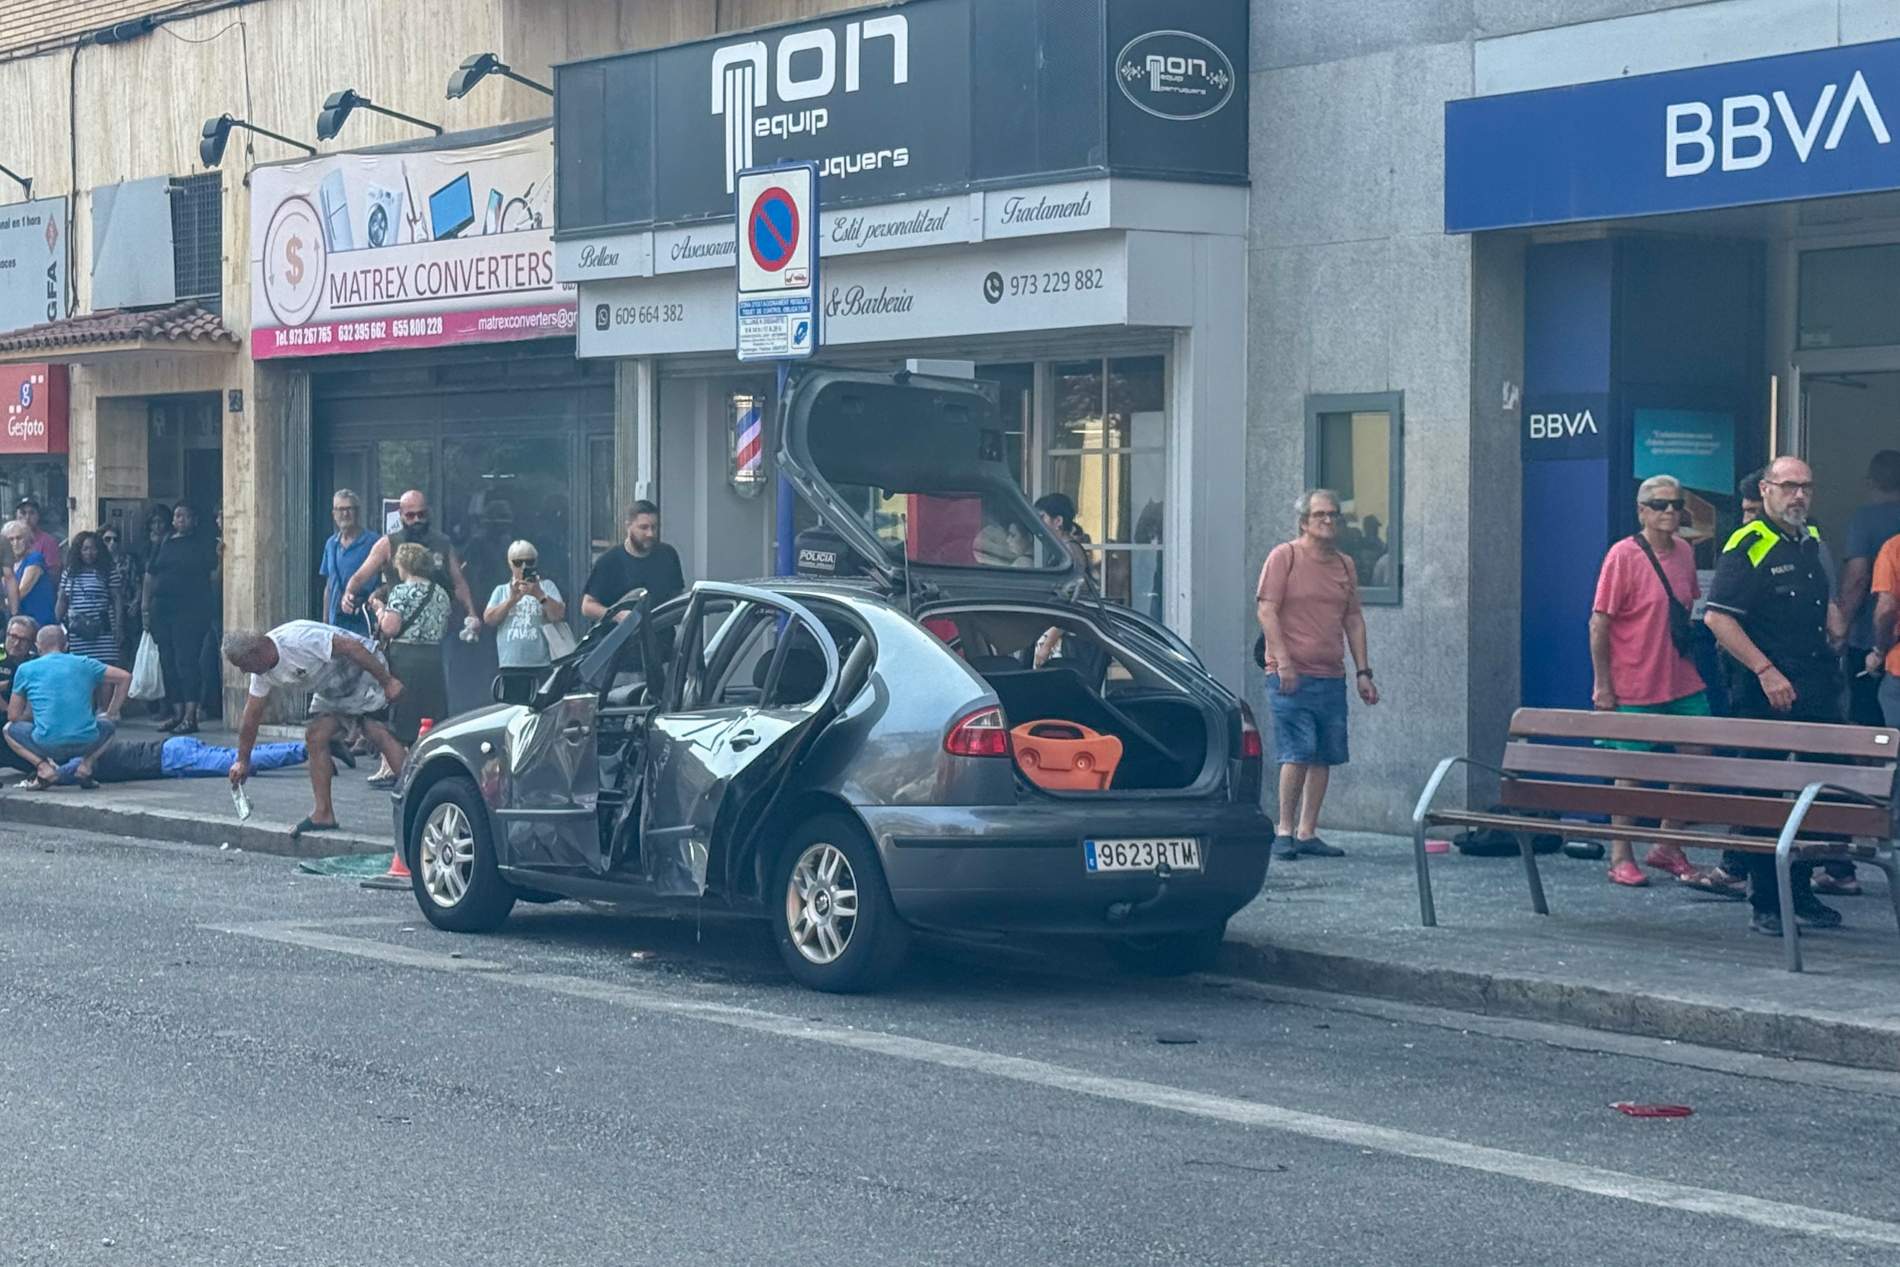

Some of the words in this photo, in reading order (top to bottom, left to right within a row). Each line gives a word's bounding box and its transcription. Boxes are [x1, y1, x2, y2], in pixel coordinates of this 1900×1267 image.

[755, 108, 828, 140] equip
[1665, 70, 1891, 178] BBVA
[815, 147, 909, 179] uquers
[1001, 191, 1091, 225] Tractaments
[47, 261, 57, 322] GFA
[330, 265, 408, 304] MATREX
[415, 250, 553, 296] CONVERTERS
[1010, 274, 1038, 296] 973
[1043, 271, 1070, 293] 229
[1075, 268, 1104, 290] 882
[616, 307, 636, 325] 609
[639, 305, 659, 323] 664
[663, 304, 684, 322] 382
[826, 287, 842, 317] &
[841, 285, 914, 317] Barberia
[275, 330, 289, 347] Tel.
[289, 328, 303, 345] 973
[409, 318, 426, 336] 800
[427, 316, 443, 335] 228
[8, 415, 44, 441] Gesfoto
[1530, 409, 1598, 438] BBVA
[1101, 842, 1194, 867] 9623BTM
